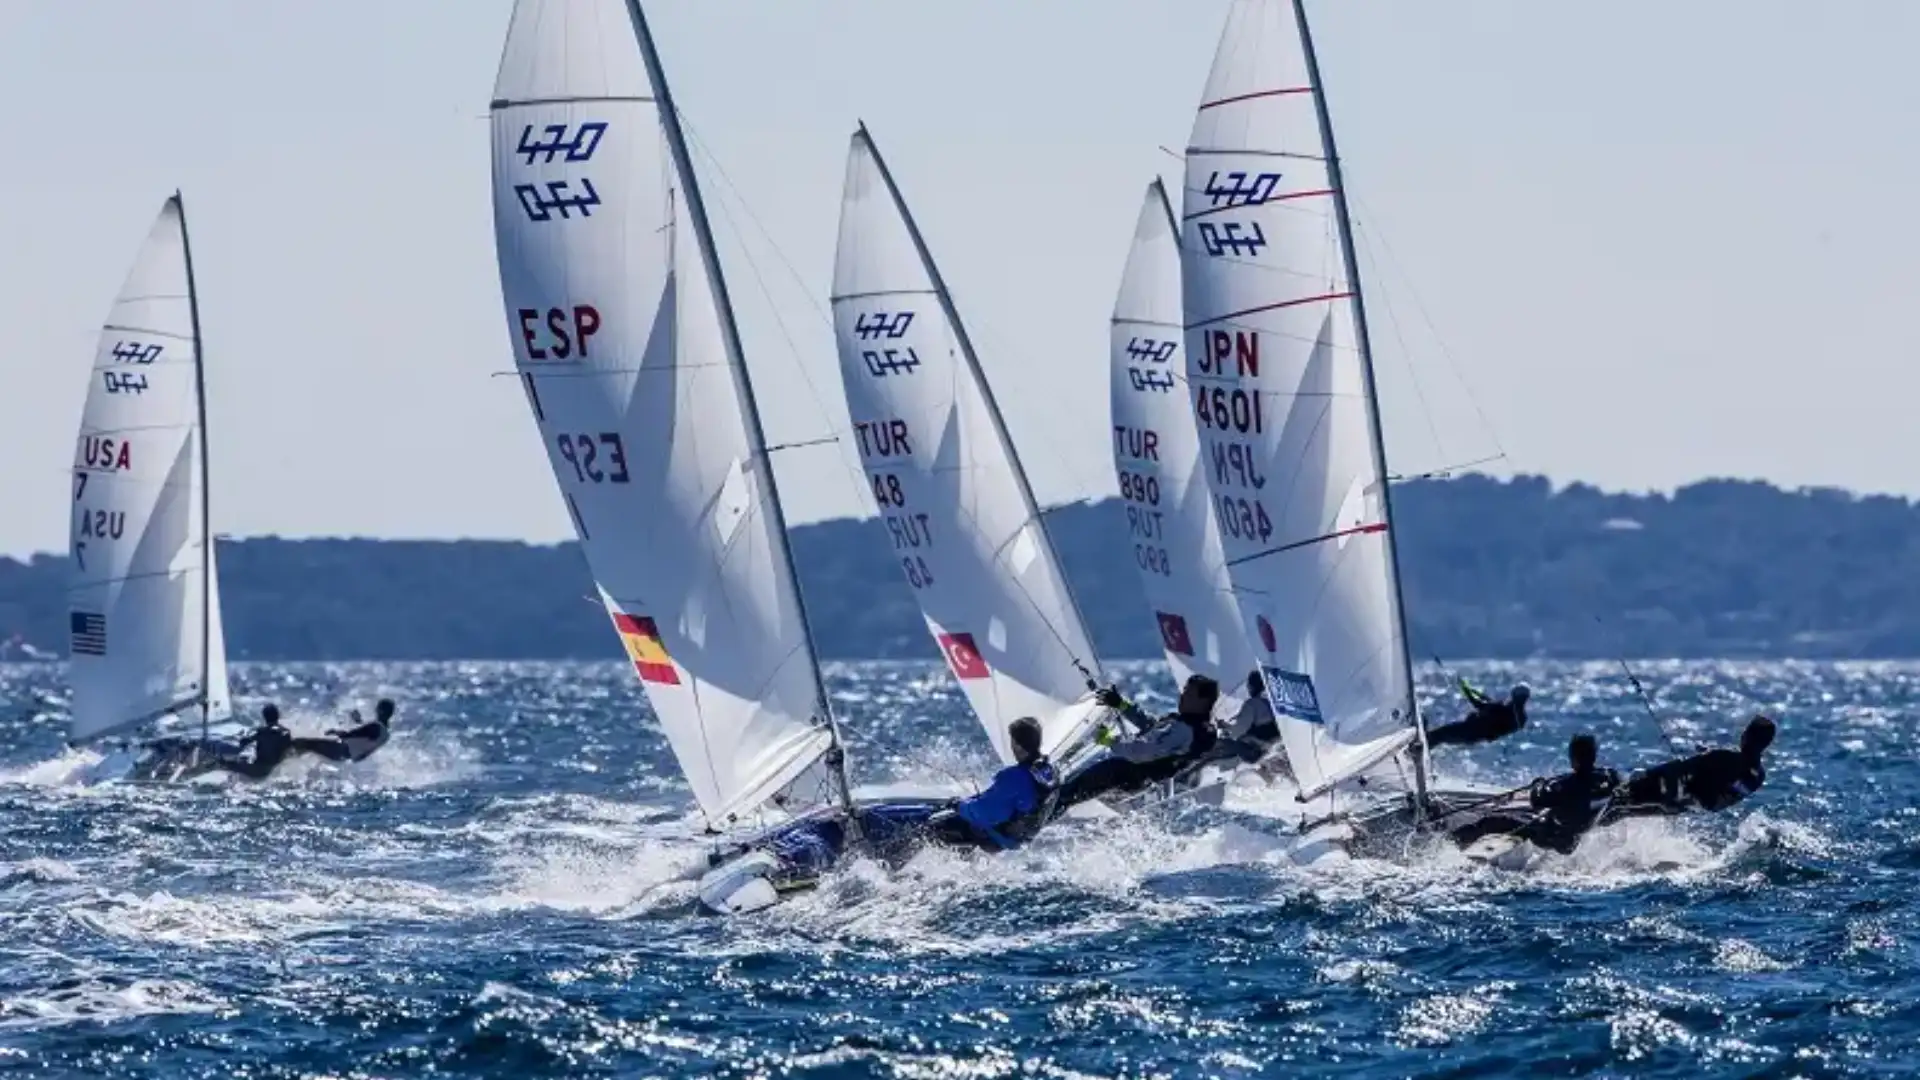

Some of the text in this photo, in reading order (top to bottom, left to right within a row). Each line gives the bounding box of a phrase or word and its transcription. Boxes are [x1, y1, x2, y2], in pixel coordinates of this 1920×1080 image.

[516, 122, 609, 165] 470
[1204, 171, 1282, 206] 470
[518, 304, 602, 359] ESP
[855, 312, 915, 340] 470
[112, 340, 164, 365] 470
[1126, 337, 1178, 363] 470
[1197, 329, 1260, 377] JPN
[1196, 384, 1262, 434] 4601
[85, 436, 132, 471] USA
[853, 420, 912, 456] TUR
[1114, 426, 1160, 462] TUR
[75, 472, 88, 500] 7
[874, 474, 905, 508] 48
[1119, 472, 1160, 506] 890
